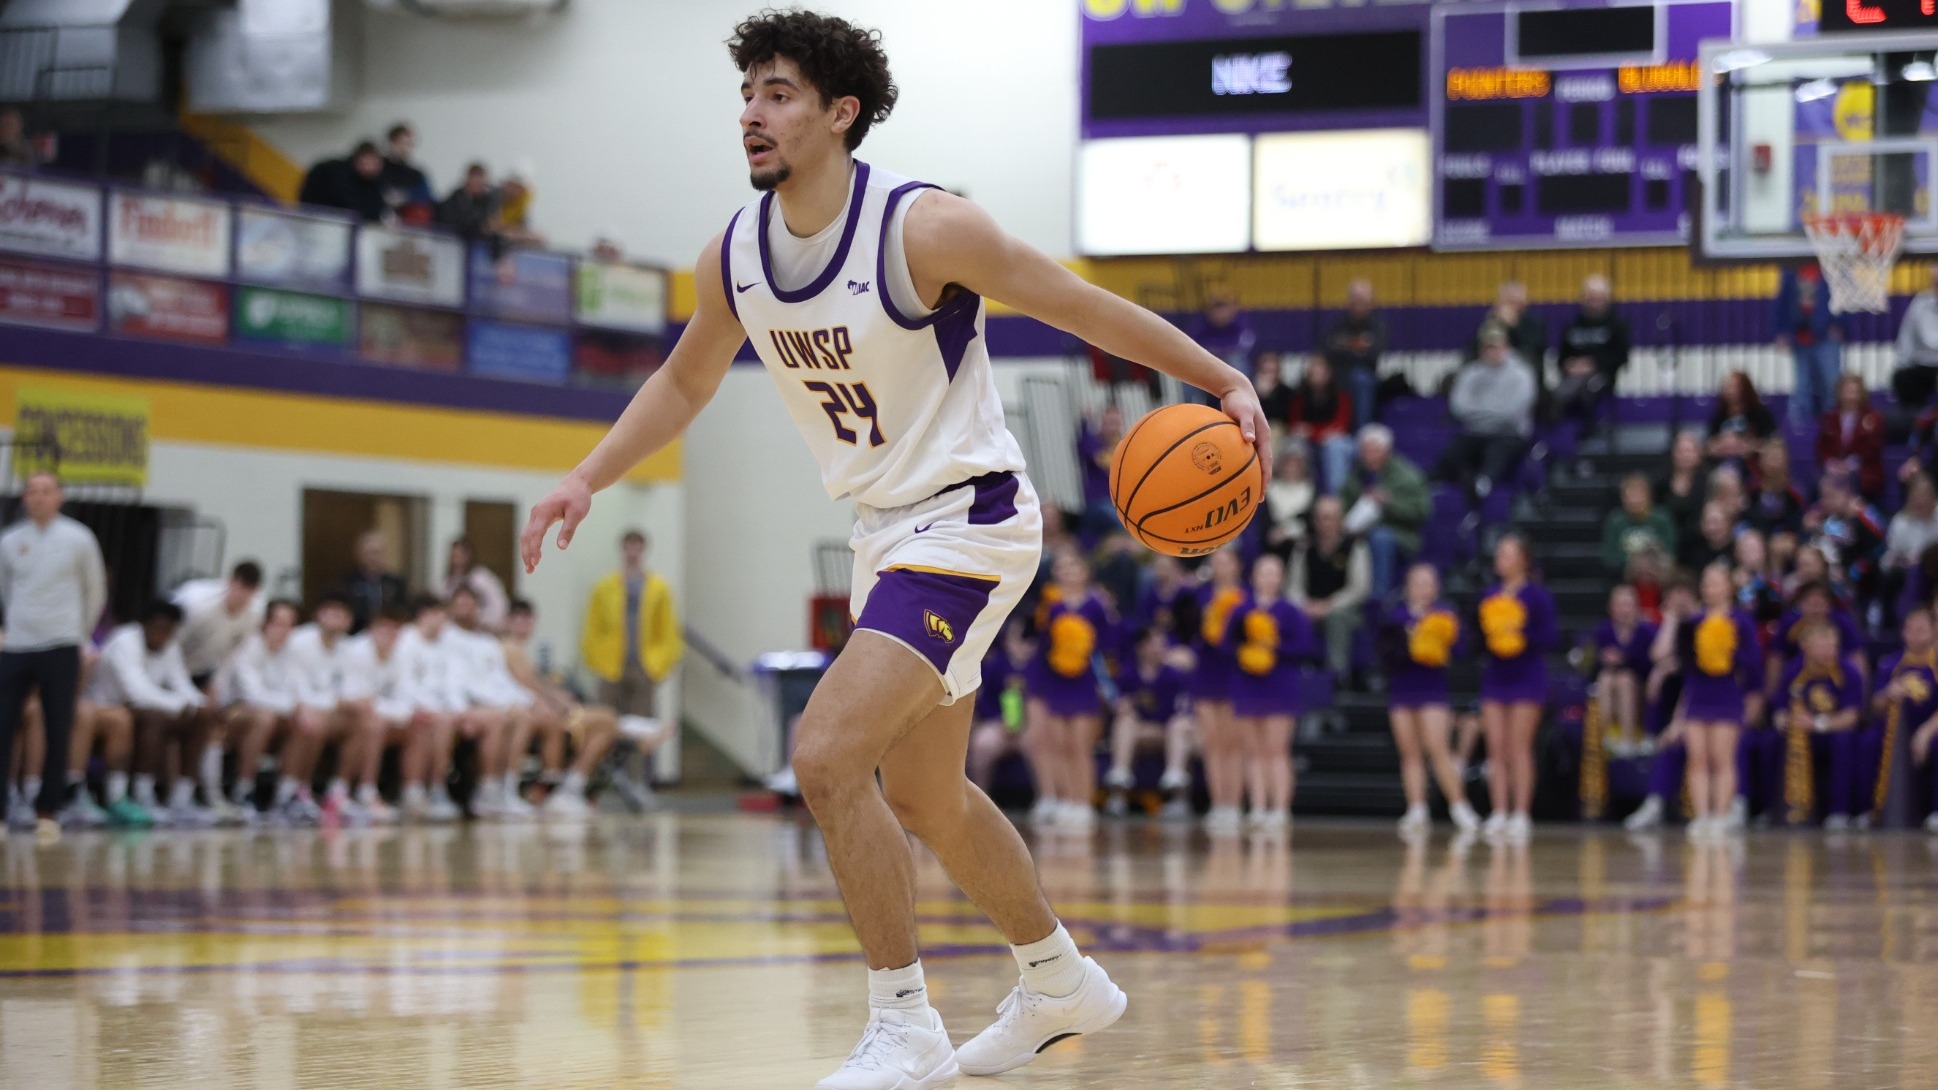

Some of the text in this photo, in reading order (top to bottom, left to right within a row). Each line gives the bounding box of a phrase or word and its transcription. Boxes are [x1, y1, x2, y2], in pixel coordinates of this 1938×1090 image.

[769, 325, 854, 371] UWSP
[801, 379, 888, 448] 24
[1185, 486, 1251, 534] EVO NXT
